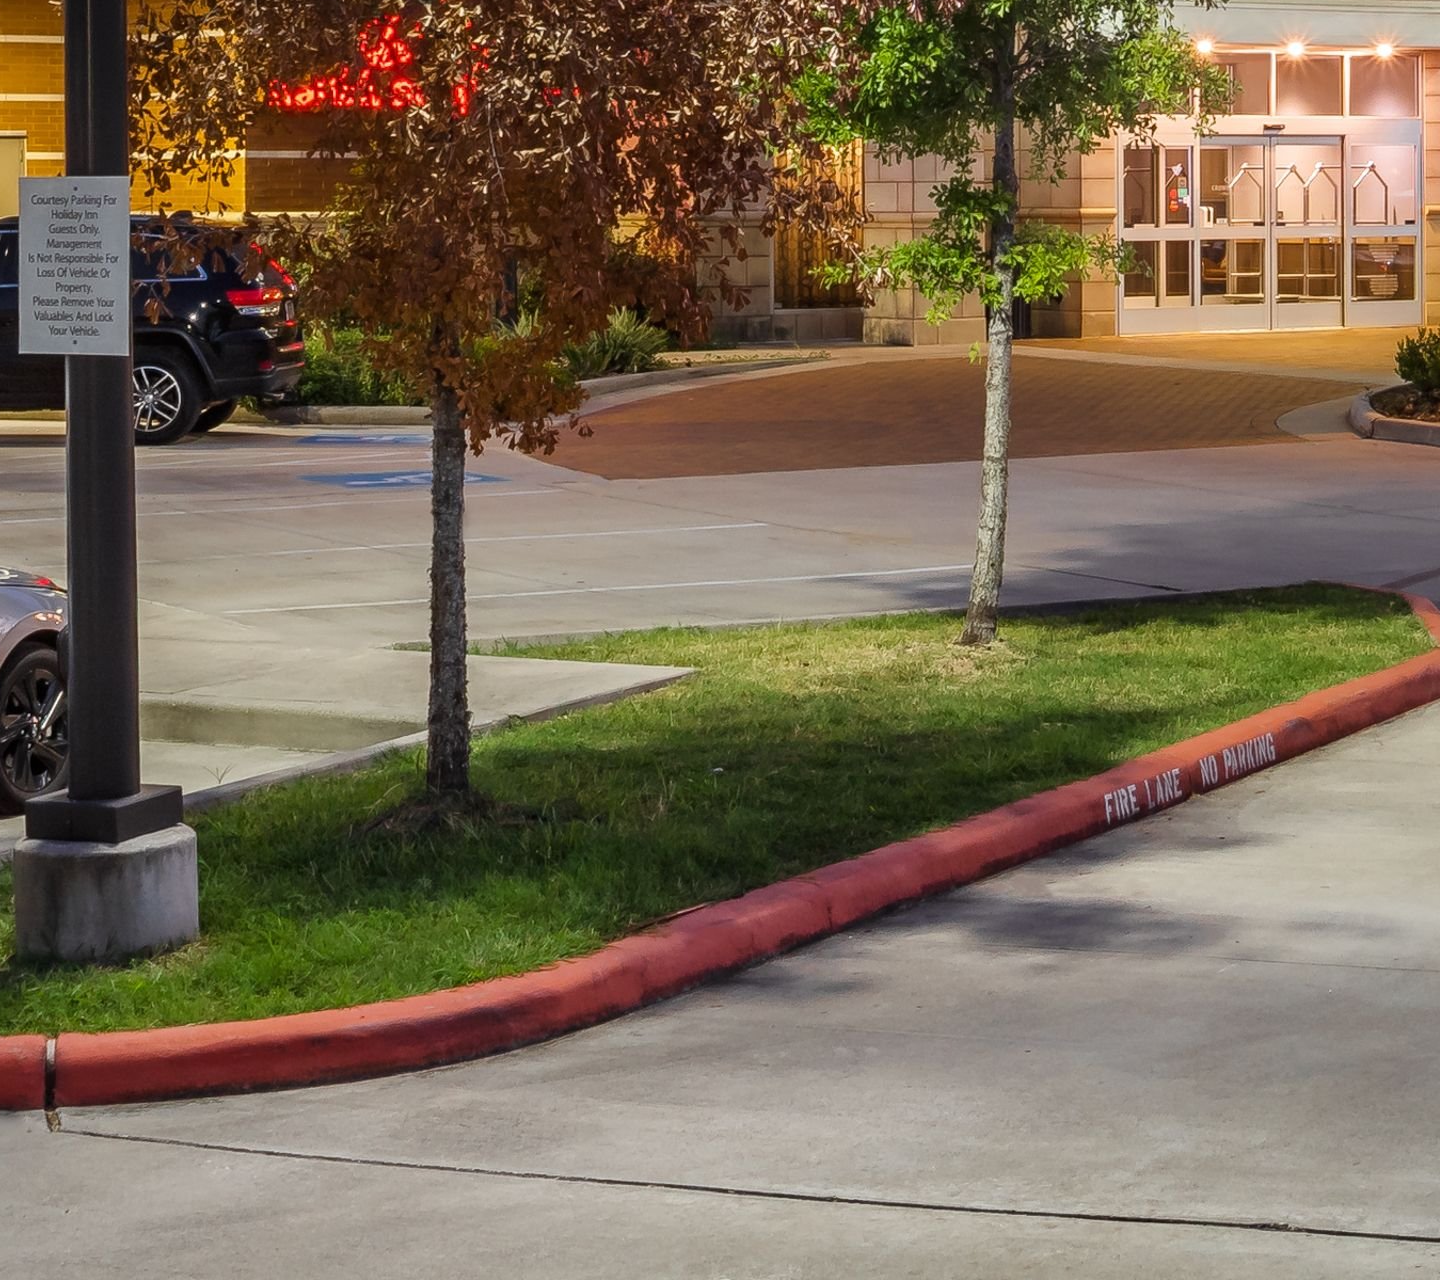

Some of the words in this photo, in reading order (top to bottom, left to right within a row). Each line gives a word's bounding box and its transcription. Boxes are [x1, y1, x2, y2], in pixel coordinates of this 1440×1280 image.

[30, 194, 69, 207] Courtesy
[71, 194, 102, 208] Parking
[103, 194, 117, 205] For
[51, 209, 83, 223] Holiday
[84, 209, 99, 220] Inn
[48, 223, 78, 234] Guests
[79, 223, 101, 237] Only.
[46, 238, 102, 251] Management
[28, 253, 35, 264] Is
[37, 253, 53, 264] Not
[54, 253, 105, 266] Responsible
[105, 253, 119, 264] For
[37, 267, 55, 278] Loss
[56, 267, 68, 278] Of
[68, 267, 99, 279] Vehicle
[100, 267, 111, 279] Or
[55, 281, 93, 295] Property.
[32, 296, 59, 307] Please
[60, 296, 95, 308] Remove
[96, 297, 115, 308] Your
[33, 310, 74, 322] Valuables
[75, 310, 94, 322] And
[94, 311, 114, 323] Lock
[48, 325, 68, 336] Your
[1103, 784, 1141, 825] FIRE
[1144, 767, 1183, 809] LANE
[1199, 755, 1219, 788] NO
[1222, 732, 1277, 780] PARKING
